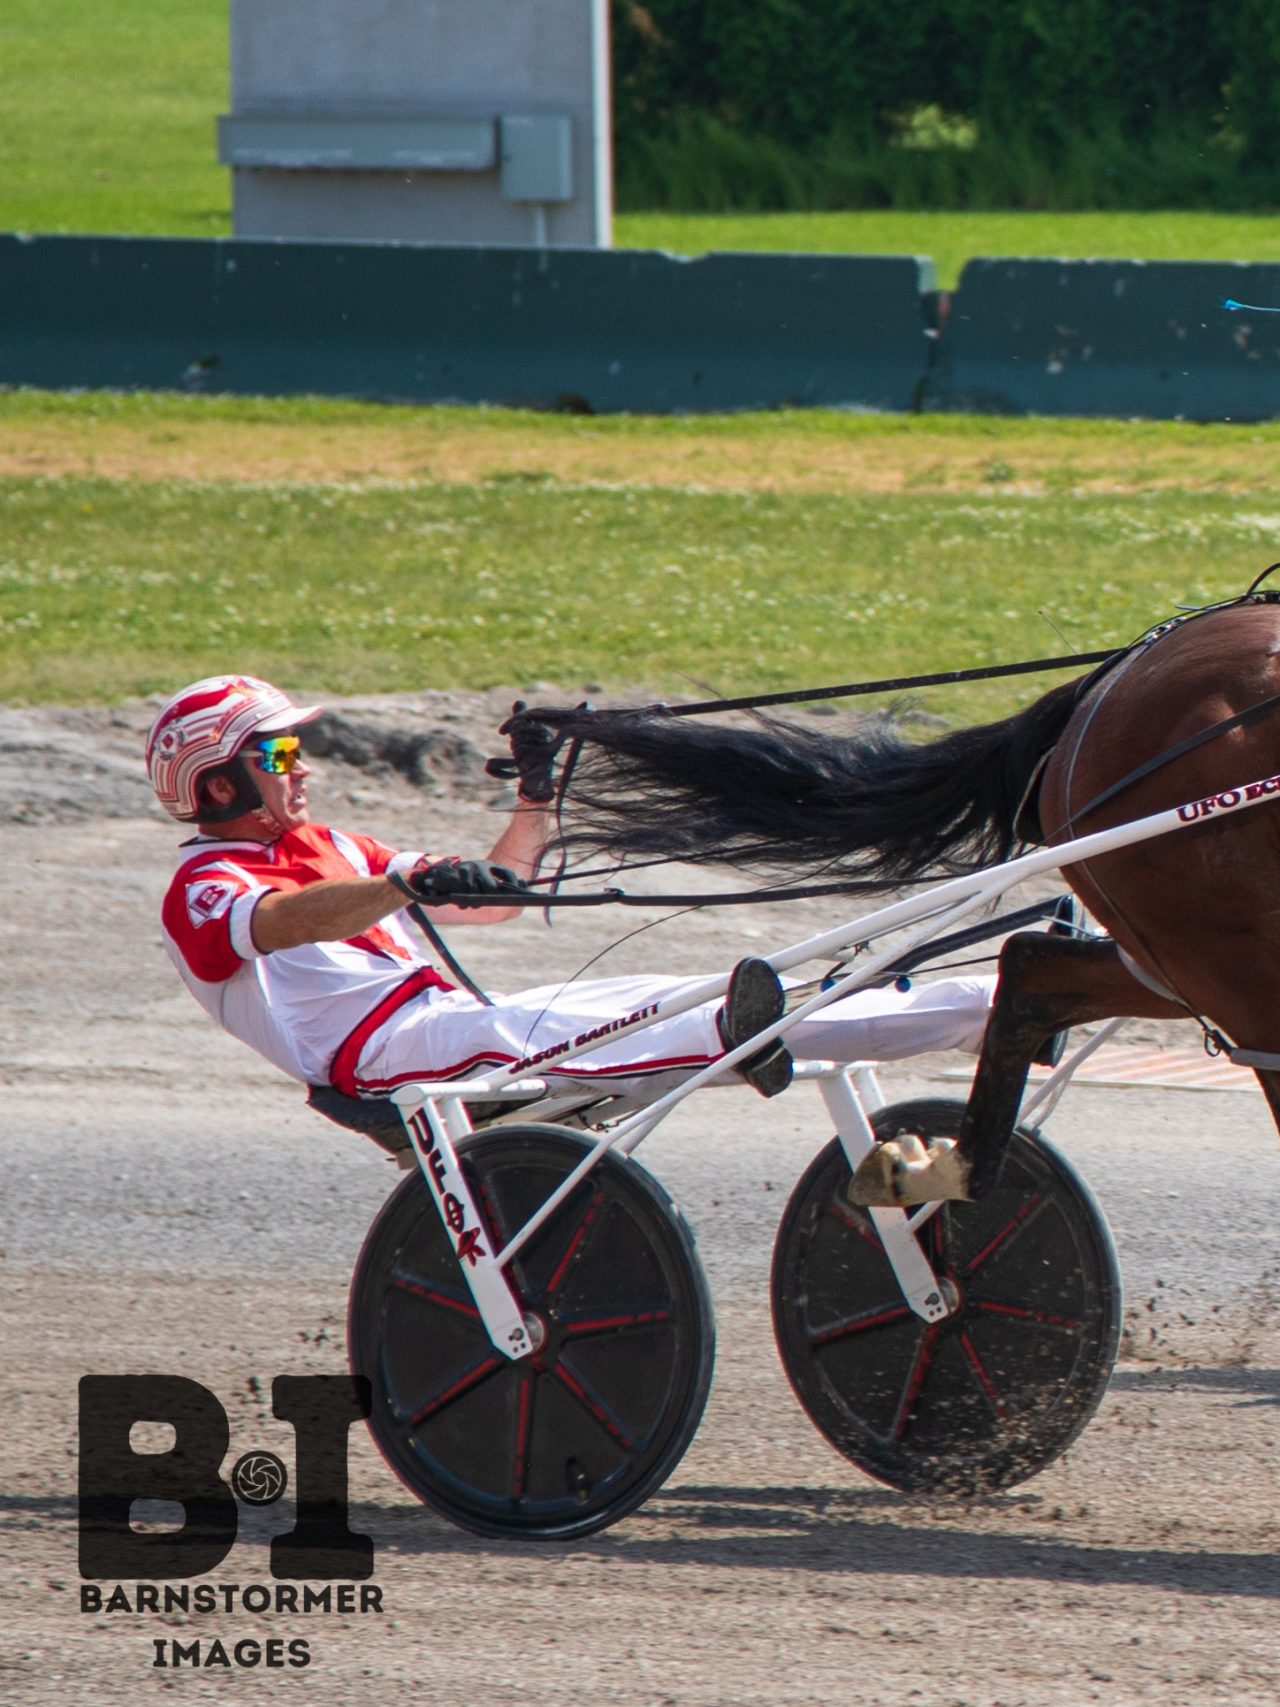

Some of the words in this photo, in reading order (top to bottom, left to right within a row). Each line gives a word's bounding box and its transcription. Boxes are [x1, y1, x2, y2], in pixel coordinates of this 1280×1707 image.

[1176, 790, 1241, 822] UFO
[508, 1039, 571, 1075] JASON
[574, 1001, 662, 1048] BARTLETT
